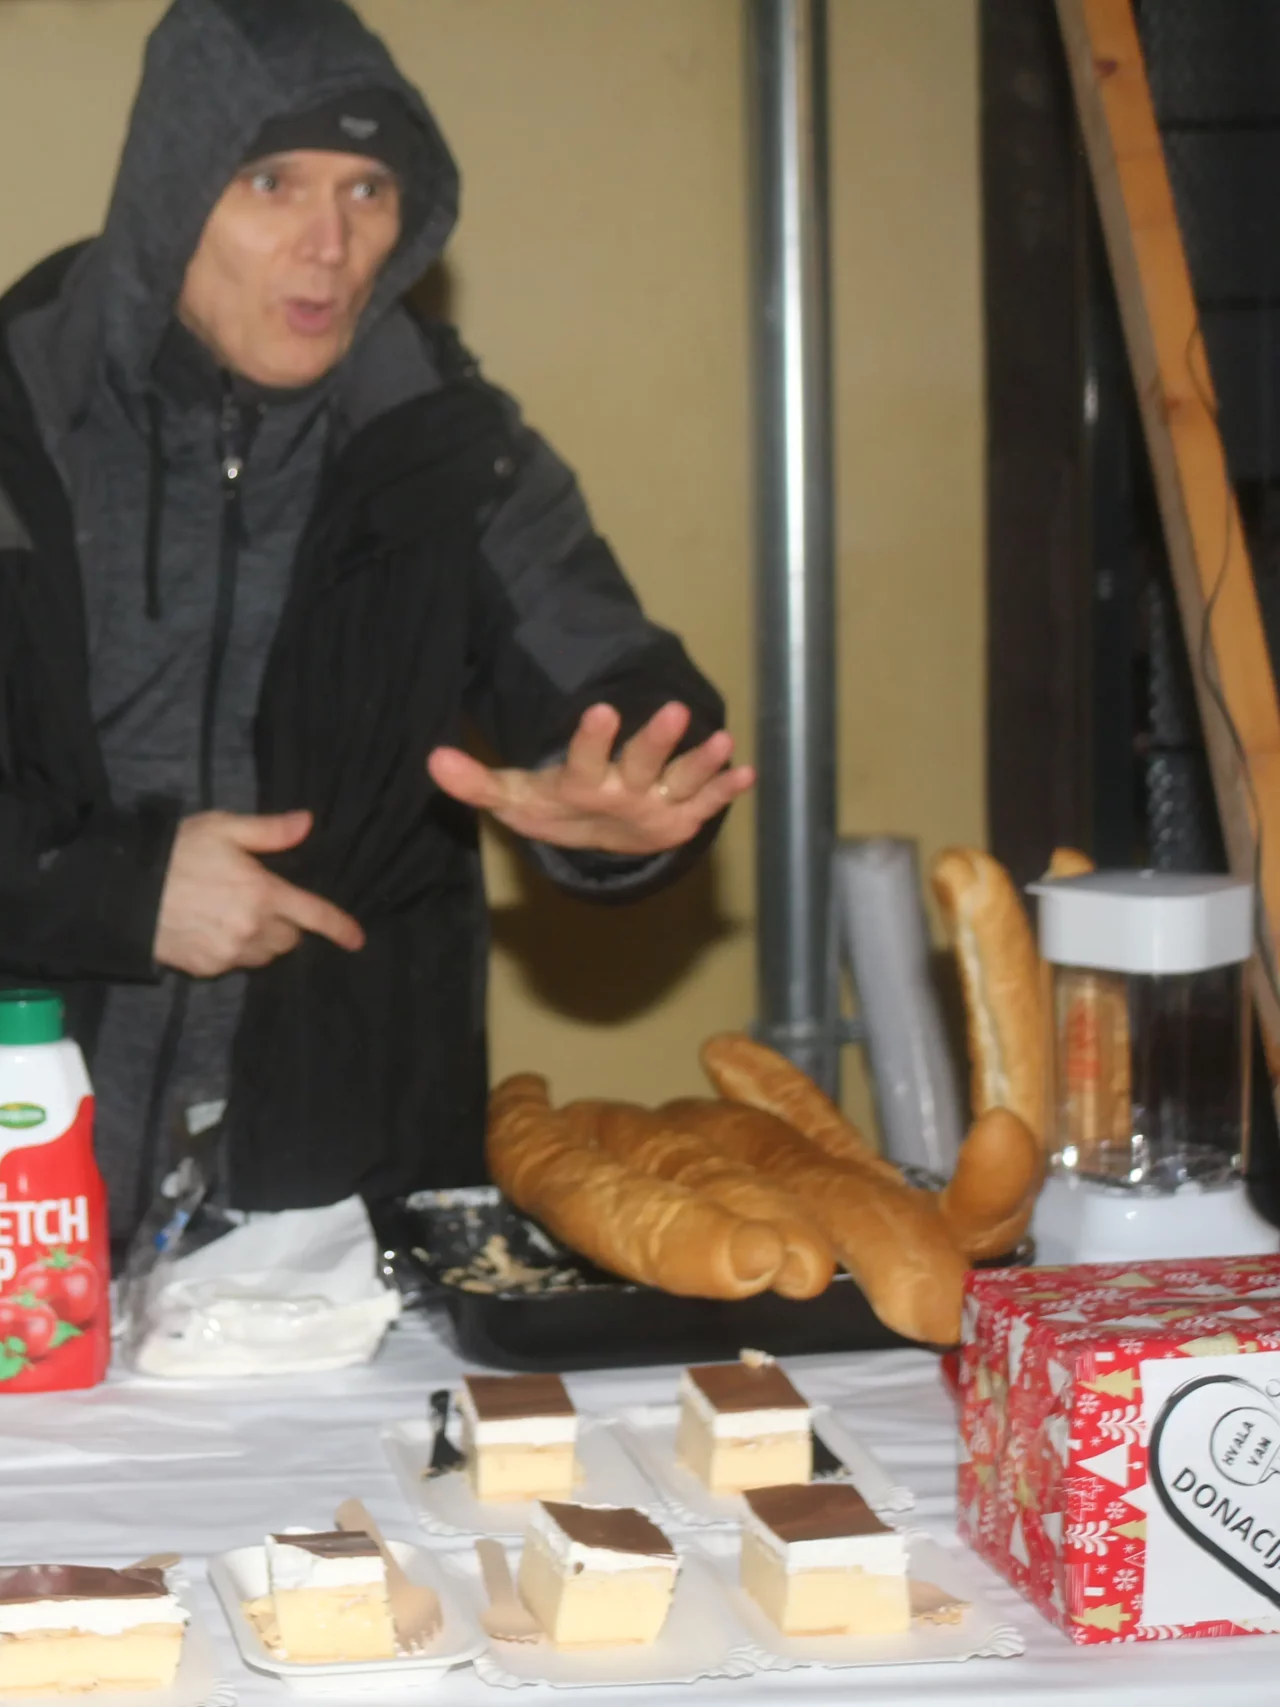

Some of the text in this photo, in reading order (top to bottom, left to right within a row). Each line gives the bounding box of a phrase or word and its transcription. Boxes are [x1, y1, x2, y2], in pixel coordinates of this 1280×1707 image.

[1221, 1421, 1255, 1466] HVALA
[1246, 1437, 1272, 1467] VAM
[1172, 1466, 1280, 1569] DONACIJ
